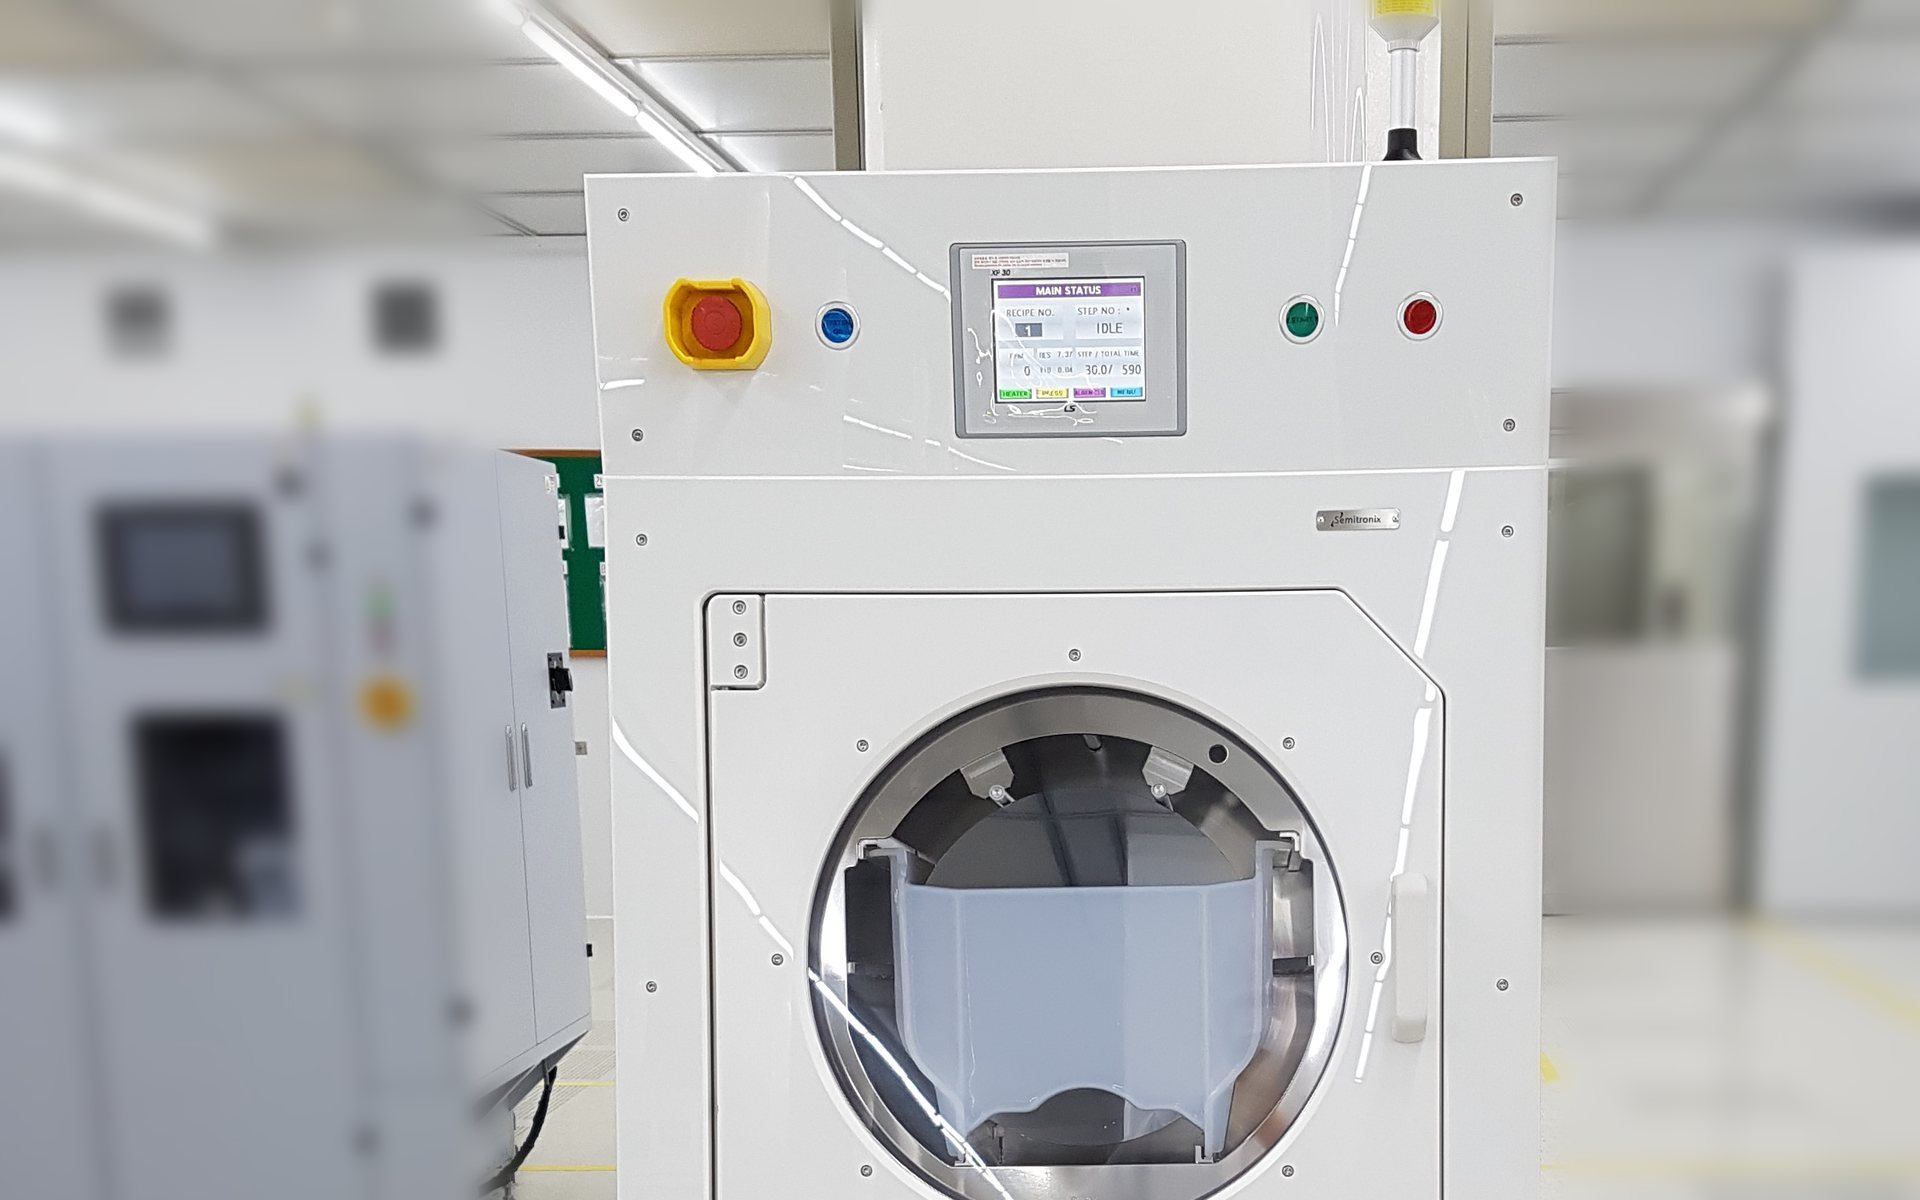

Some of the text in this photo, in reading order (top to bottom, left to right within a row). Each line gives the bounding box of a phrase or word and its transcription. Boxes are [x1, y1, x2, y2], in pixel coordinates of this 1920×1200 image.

[1035, 285, 1102, 296] MAIN STATUS
[1006, 308, 1055, 317] RECIPE NO.
[1077, 307, 1098, 315] STEP
[1025, 325, 1031, 337] 1
[1097, 322, 1123, 334] IDLE
[1024, 365, 1031, 376] 0
[1122, 364, 1142, 375] 590
[1334, 514, 1382, 525] Semitronix
